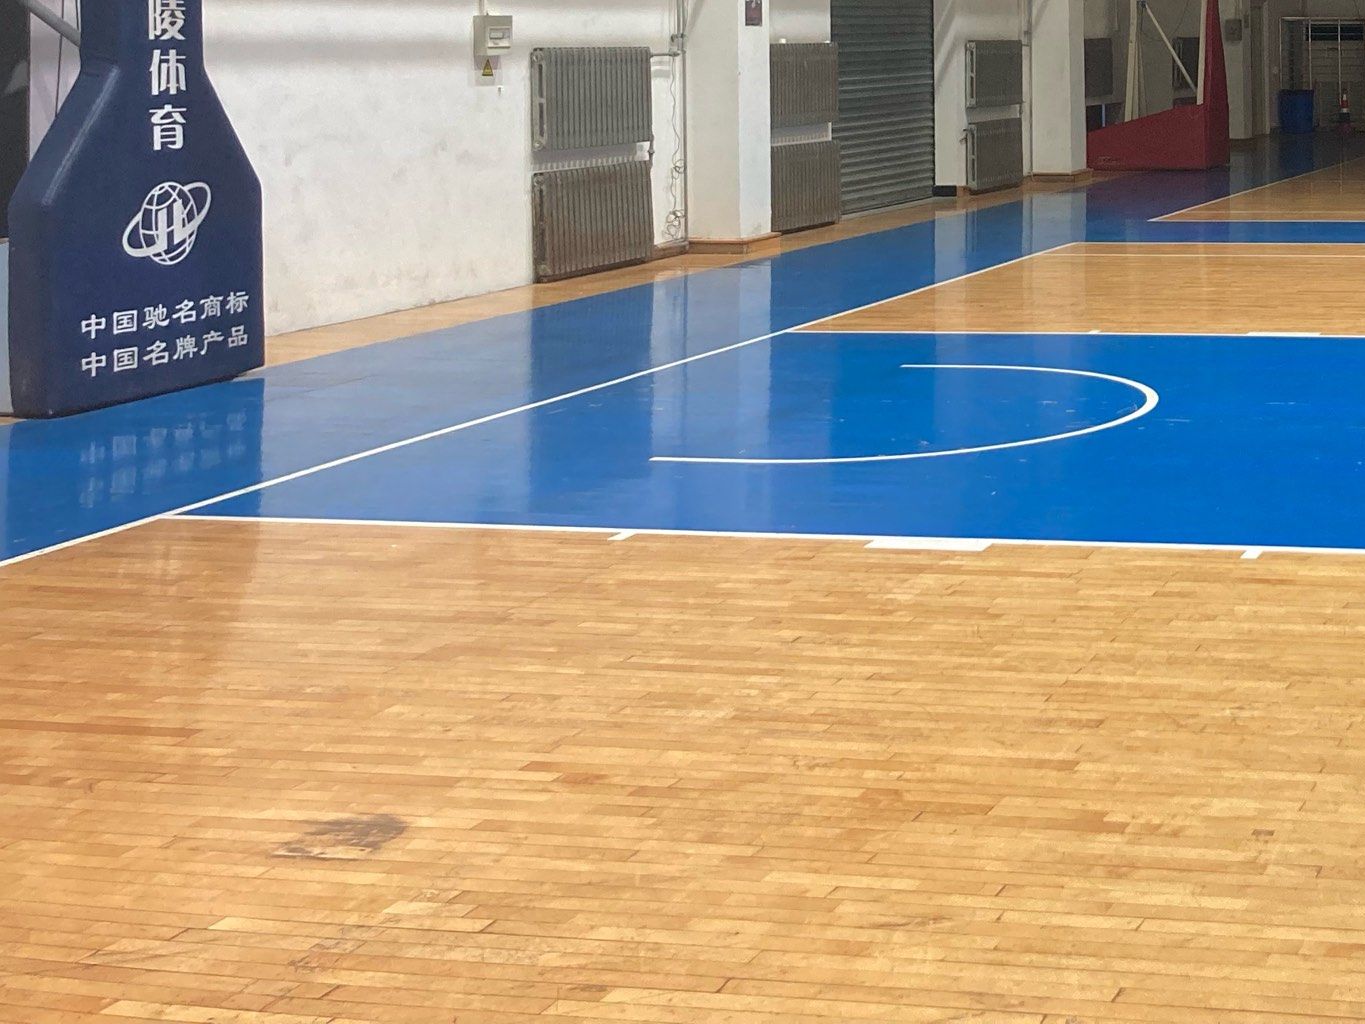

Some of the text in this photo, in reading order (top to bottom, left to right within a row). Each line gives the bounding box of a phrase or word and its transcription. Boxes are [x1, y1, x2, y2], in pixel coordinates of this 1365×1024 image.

[81, 291, 250, 340] 中国驰名商标
[81, 325, 248, 377] 中国名牌产品
